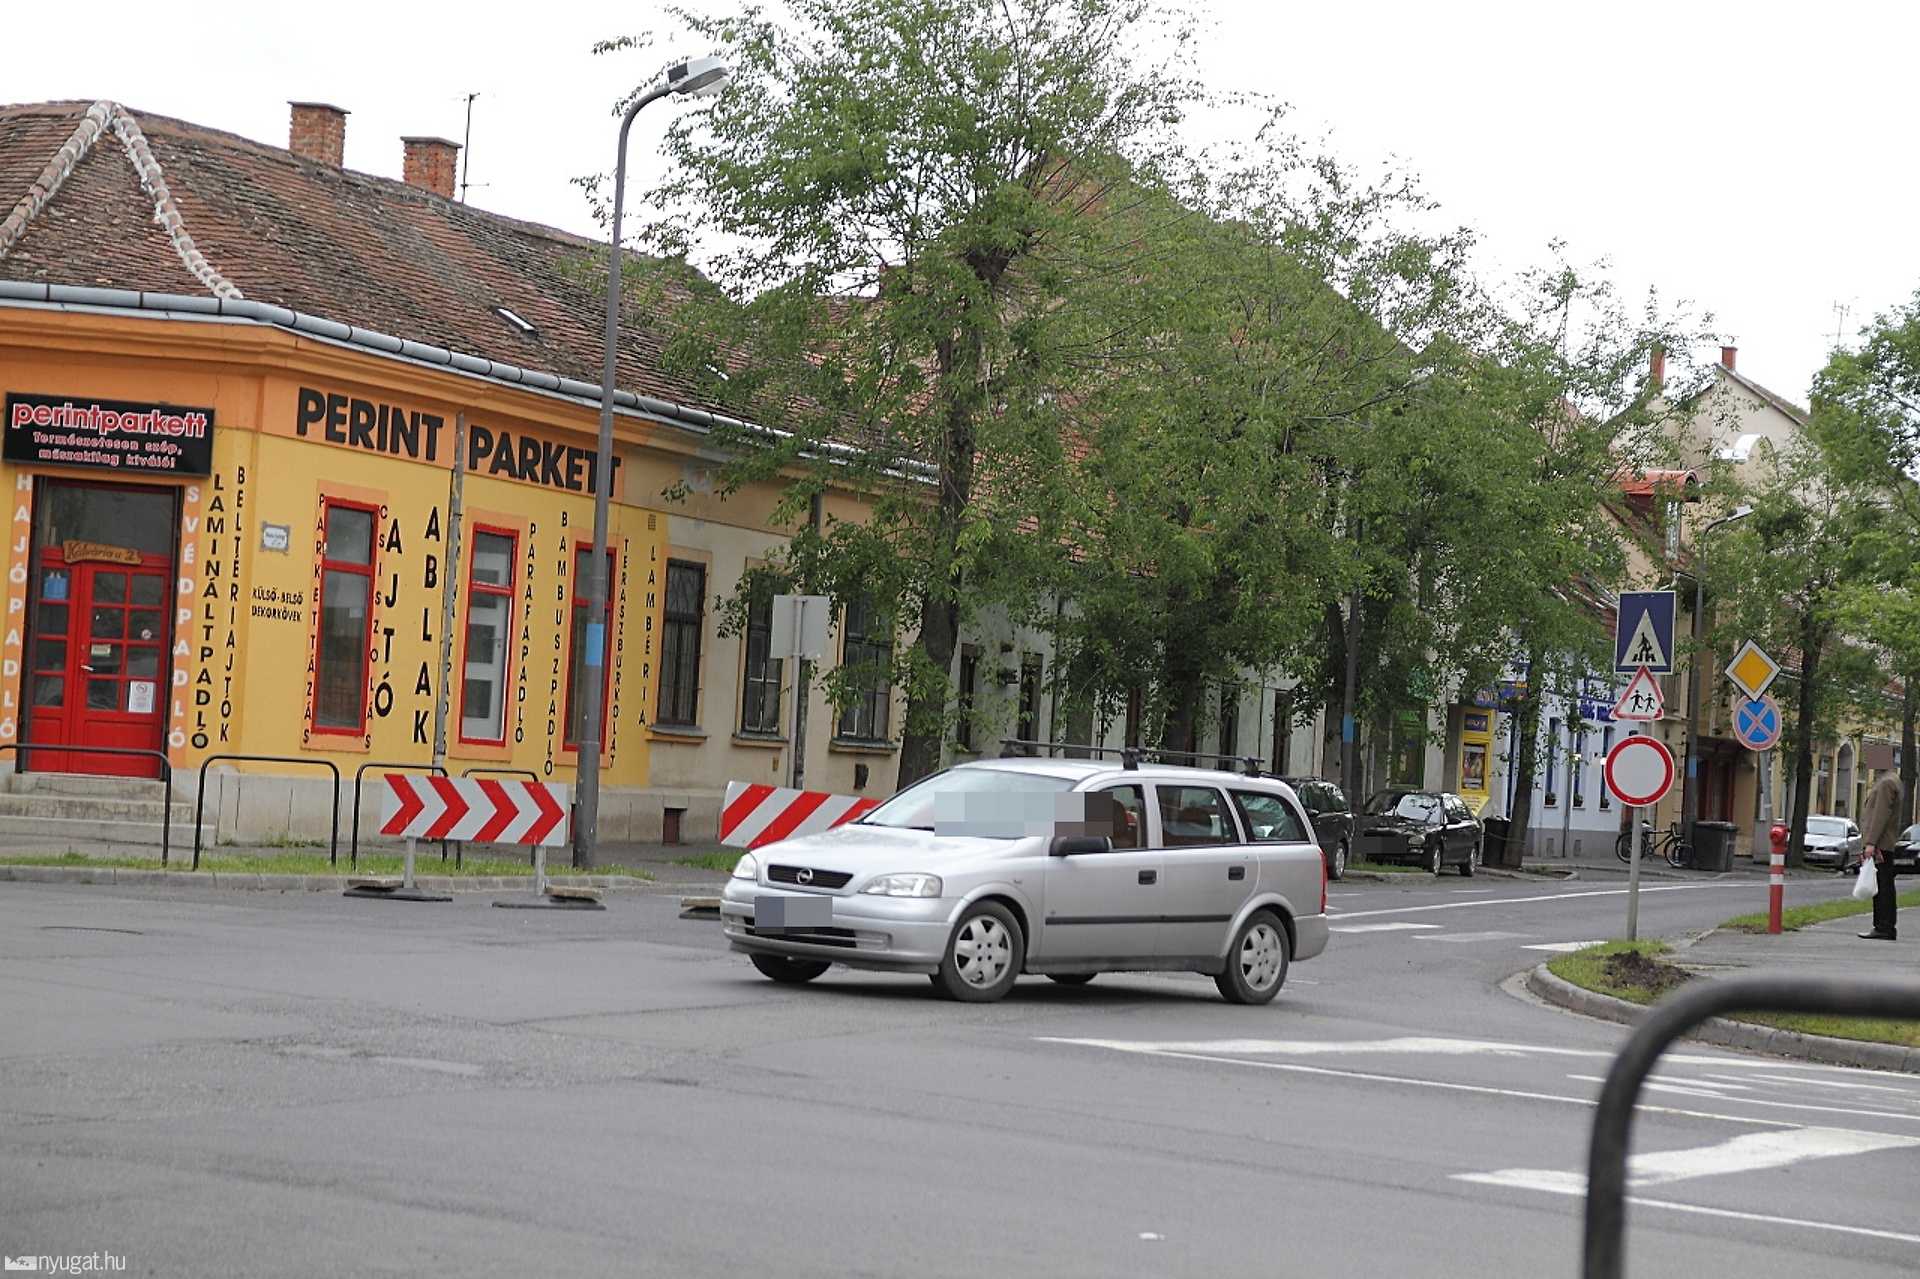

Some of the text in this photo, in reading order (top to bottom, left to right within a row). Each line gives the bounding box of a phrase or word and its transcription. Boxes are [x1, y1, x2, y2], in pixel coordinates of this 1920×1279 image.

[12, 403, 206, 437] perintparkett
[297, 386, 444, 461] PERINT
[0, 474, 33, 738] HAJÓPADLÓ
[375, 518, 402, 717] AJTÓ
[413, 506, 440, 744] ABLAK
[639, 546, 656, 725] LAMBÉRIA
